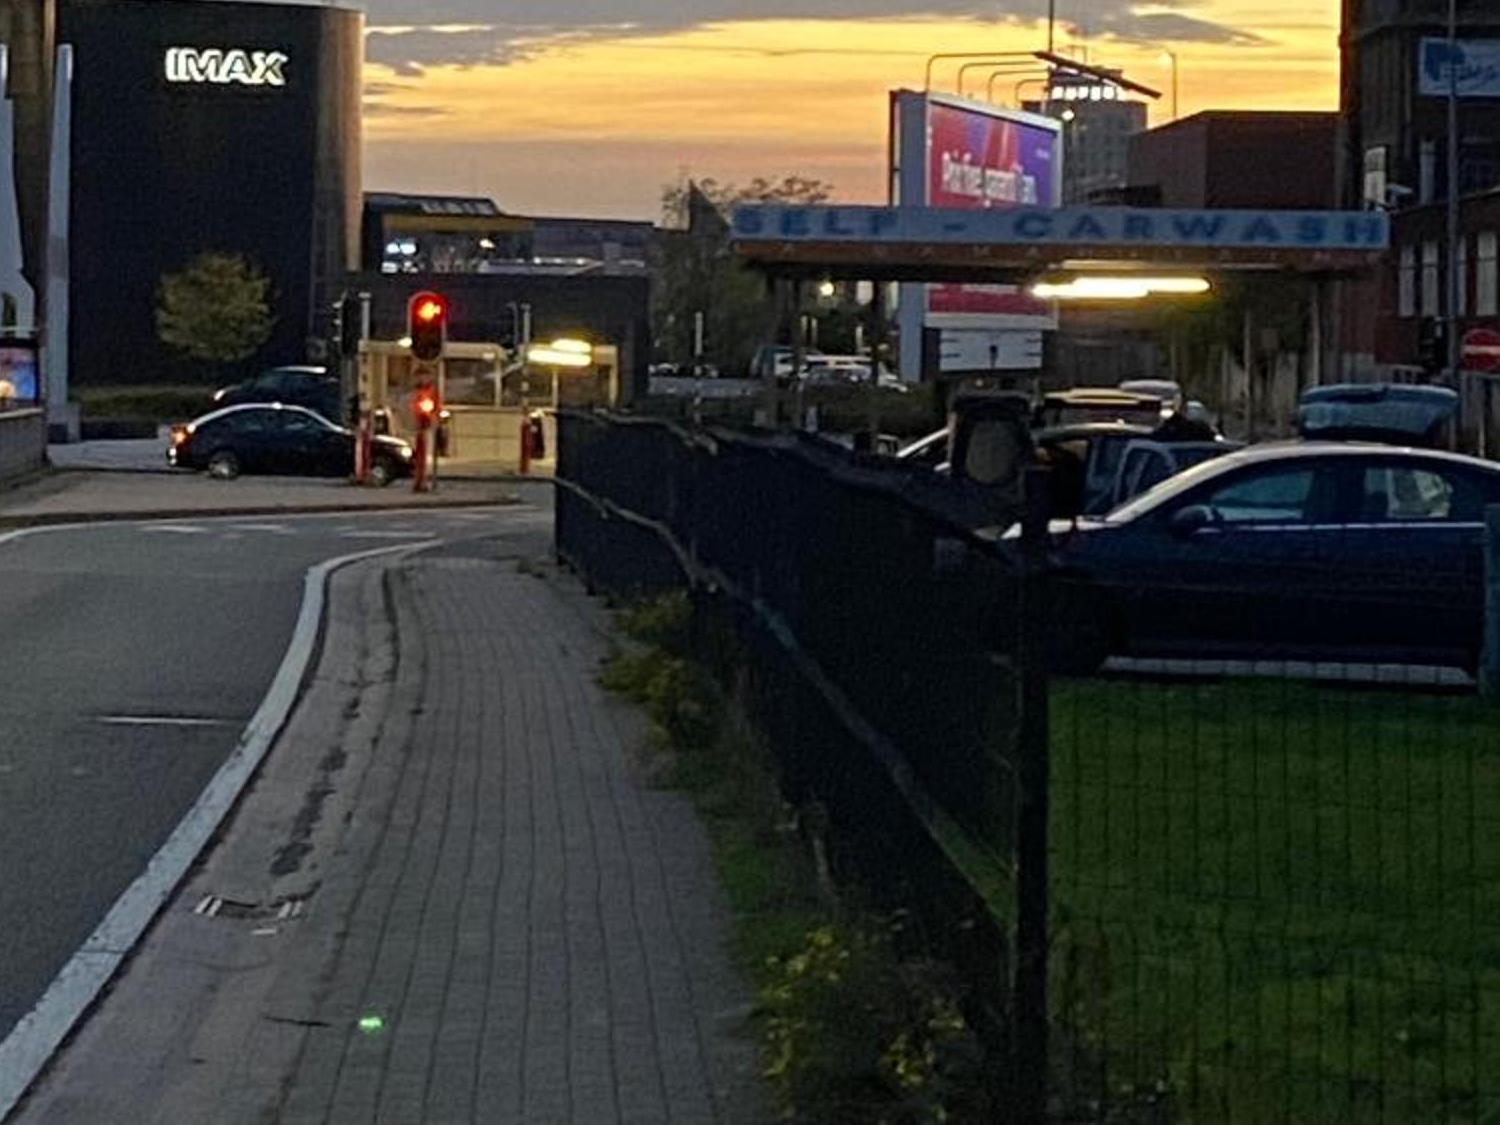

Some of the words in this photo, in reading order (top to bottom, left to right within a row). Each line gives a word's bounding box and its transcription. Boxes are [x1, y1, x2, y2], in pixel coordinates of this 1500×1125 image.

[166, 47, 289, 85] IMAX
[736, 207, 899, 236] SELF
[1013, 212, 1383, 244] CARWASH
